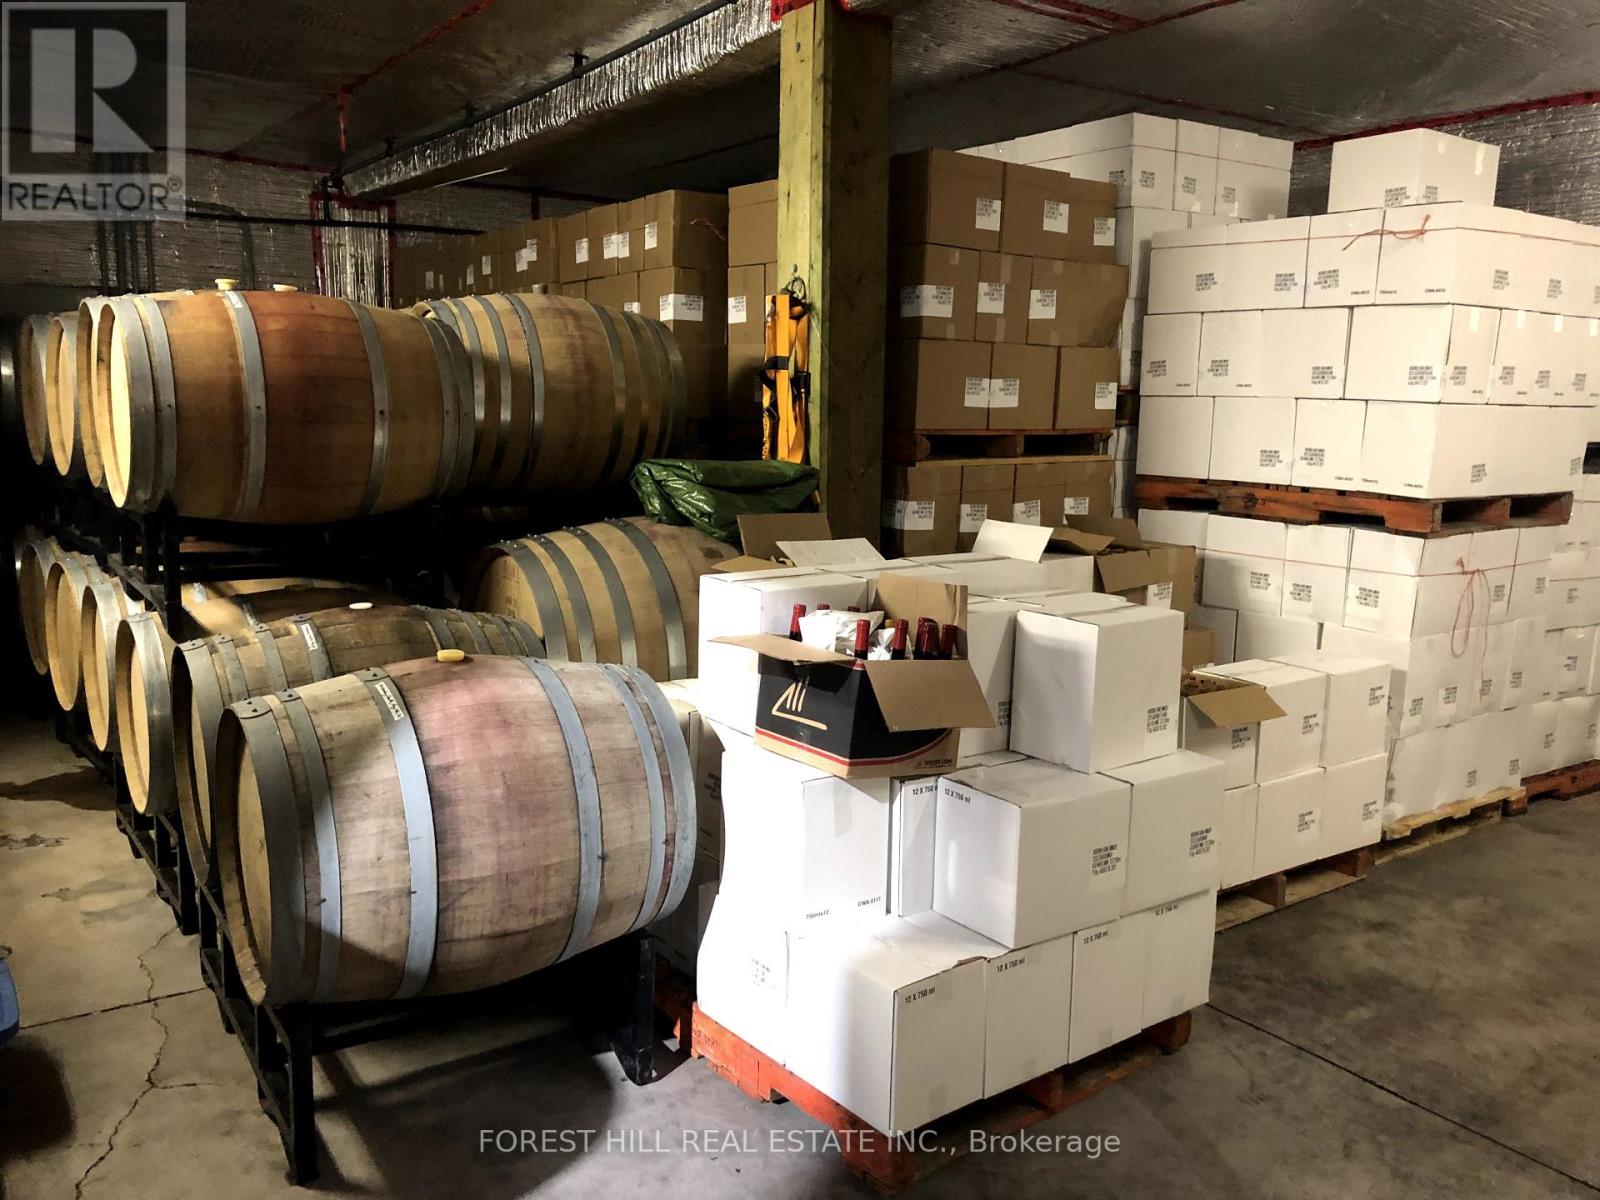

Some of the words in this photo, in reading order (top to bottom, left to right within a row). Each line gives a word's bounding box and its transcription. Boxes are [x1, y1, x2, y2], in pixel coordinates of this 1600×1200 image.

[905, 994, 911, 1004] 12
[917, 989, 928, 999] 750
[928, 985, 936, 995] ml
